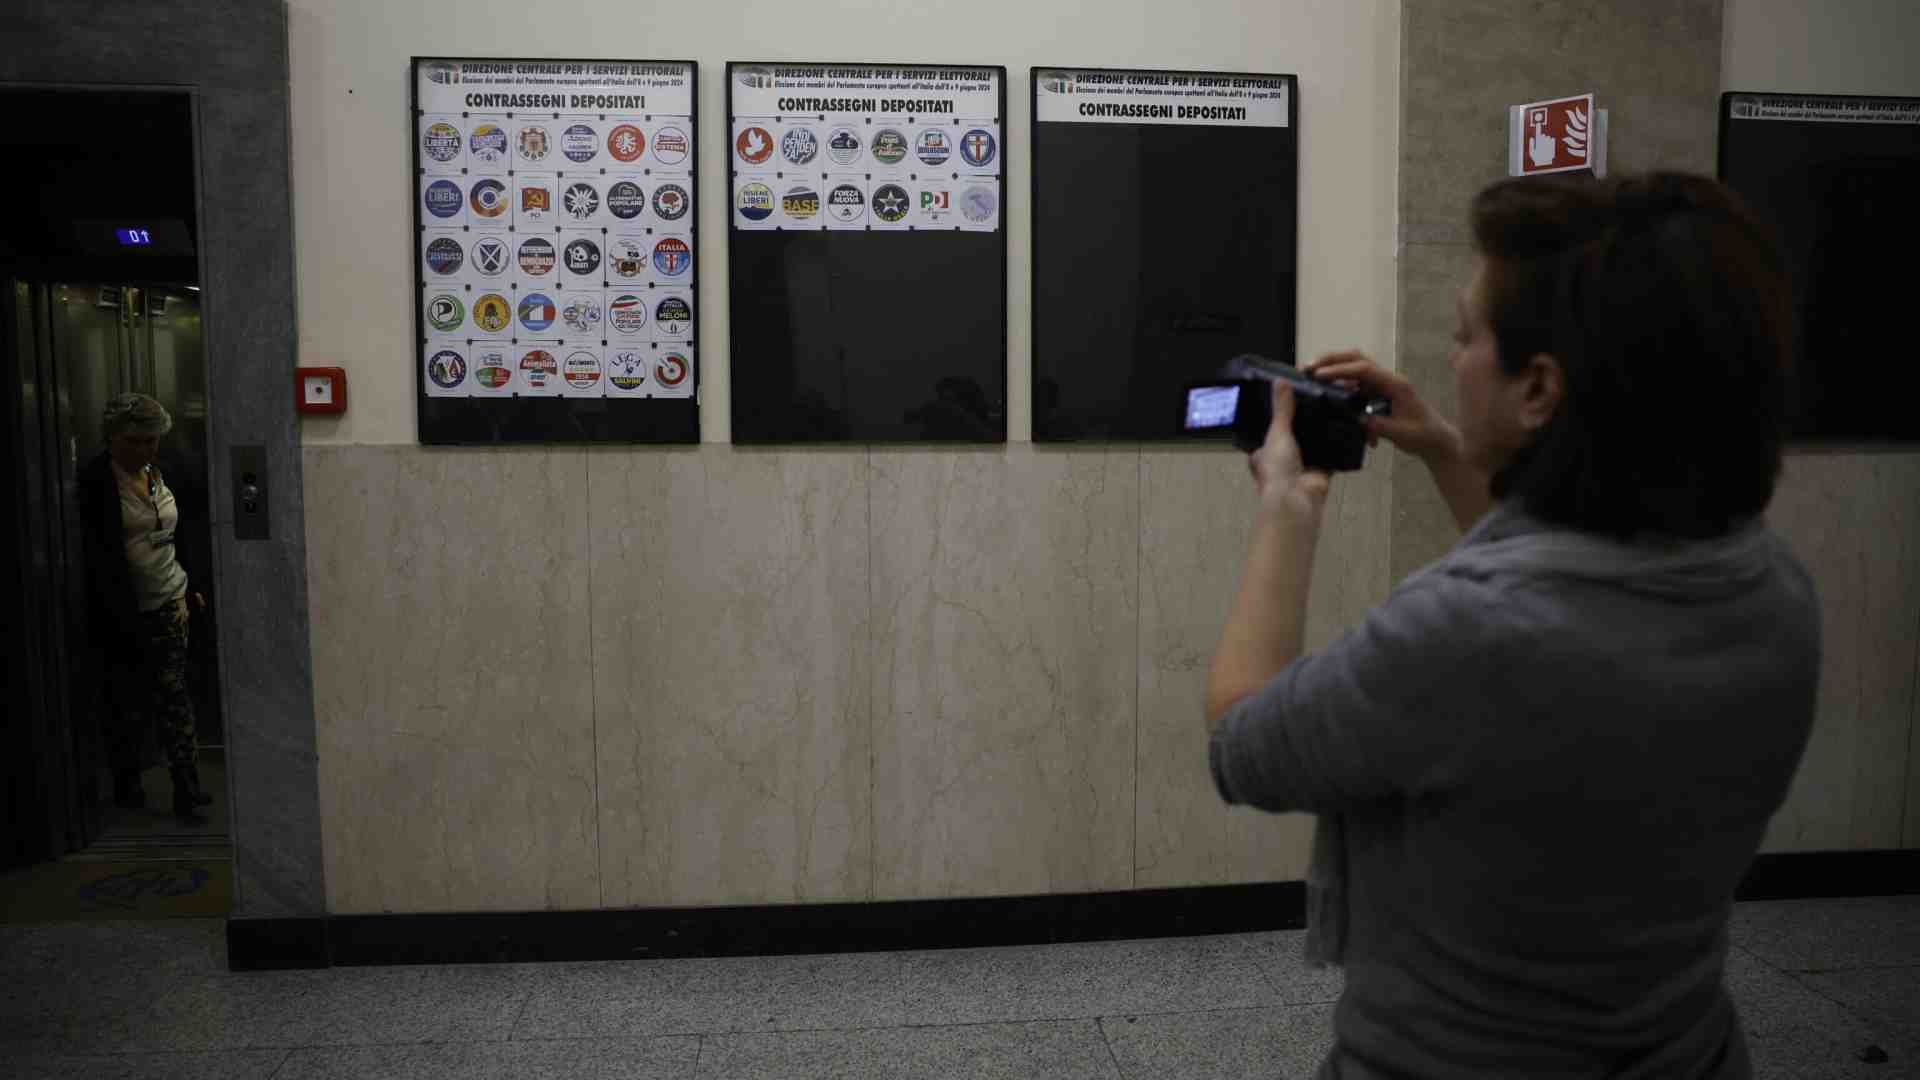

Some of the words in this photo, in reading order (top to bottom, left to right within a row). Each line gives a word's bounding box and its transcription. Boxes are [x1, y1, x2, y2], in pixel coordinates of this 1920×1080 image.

[462, 64, 513, 74] DIREZIONE
[517, 64, 561, 74] CENTRALE
[565, 65, 580, 75] PER
[593, 65, 628, 75] SERVIZI
[631, 66, 684, 76] ELETTORALI
[774, 69, 824, 79] DIREZIONE
[828, 70, 872, 79] CENTRALE
[875, 70, 892, 79] PER
[902, 70, 936, 80] SERVIZI
[940, 71, 991, 80] ELETTORALI
[1076, 74, 1124, 84] DIREZIONE
[1127, 76, 1170, 85] CENTRALE
[1172, 77, 1188, 86] PER
[1198, 77, 1230, 87] SERVIZI
[1233, 78, 1280, 88] ELETTORALI
[465, 93, 566, 107] CONTRASSEGNI
[571, 94, 645, 108] DEPOSITATI
[778, 98, 876, 112] CONTRASSEGNI
[880, 99, 953, 113] DEPOSITATI
[1078, 103, 1172, 118] CONTRASSEGNI
[1178, 105, 1246, 120] DEPOSITATI
[657, 243, 688, 251] ITALIA
[611, 351, 642, 368] LEGA
